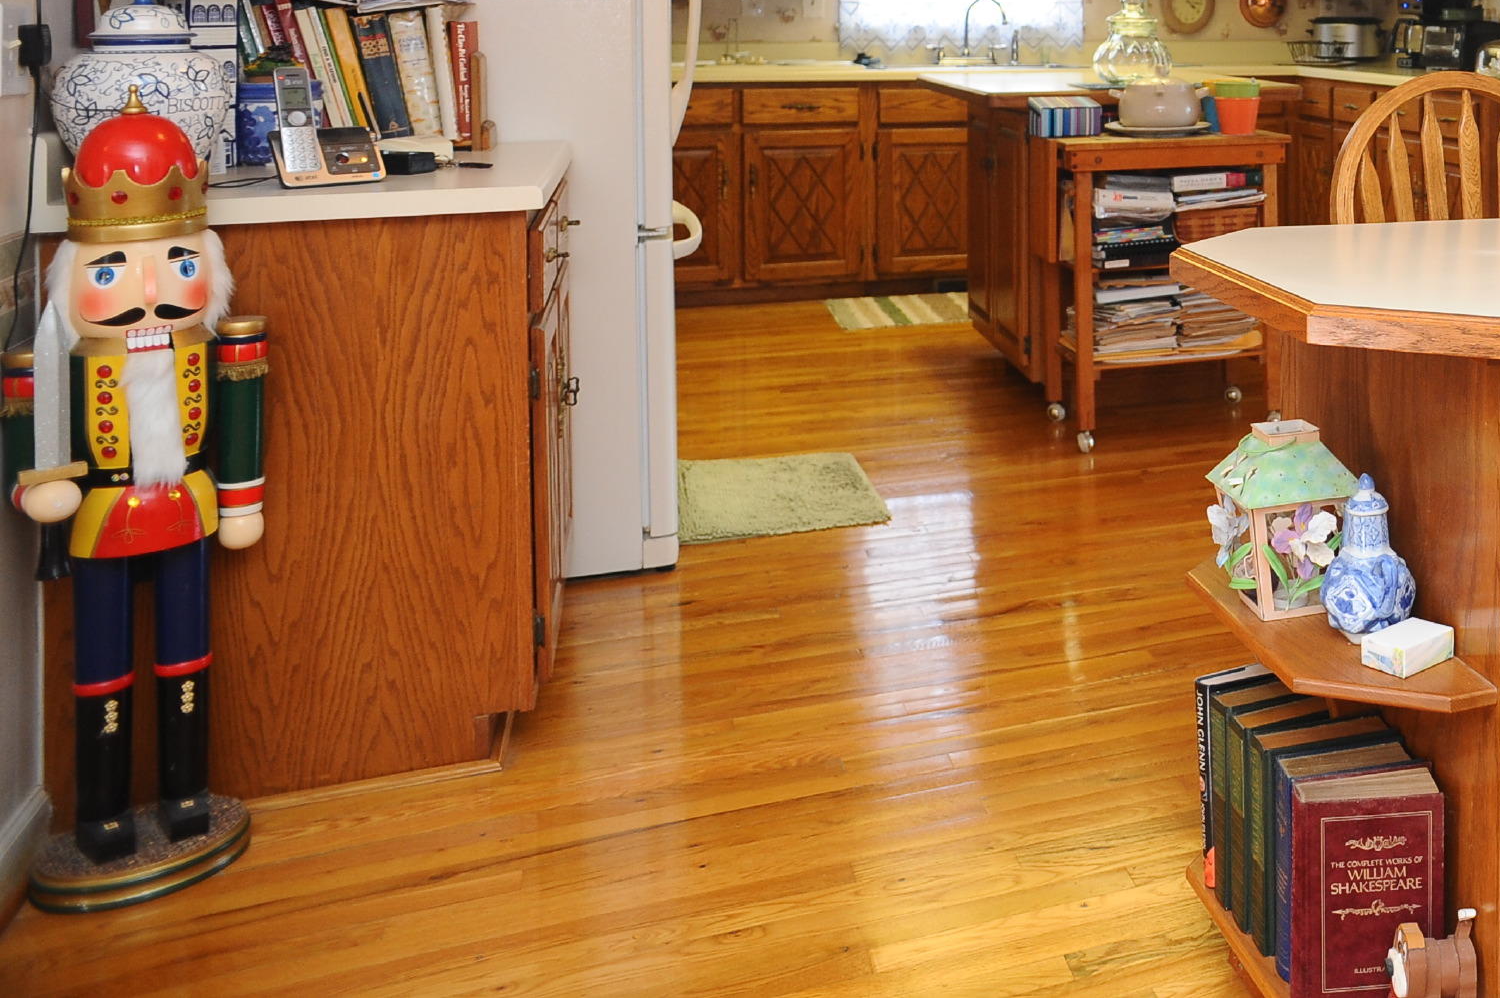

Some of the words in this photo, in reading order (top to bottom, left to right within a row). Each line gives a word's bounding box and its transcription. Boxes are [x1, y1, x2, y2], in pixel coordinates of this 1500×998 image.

[1196, 689, 1204, 726] JOHN
[1197, 728, 1206, 771] GLENN
[1330, 861, 1346, 869] THE
[1346, 858, 1383, 868] COMPLETE
[1386, 857, 1412, 866] WORKS
[1414, 855, 1424, 864] OF
[1347, 866, 1407, 881] WILLIAM
[1330, 877, 1423, 895] SHAKESPEARE
